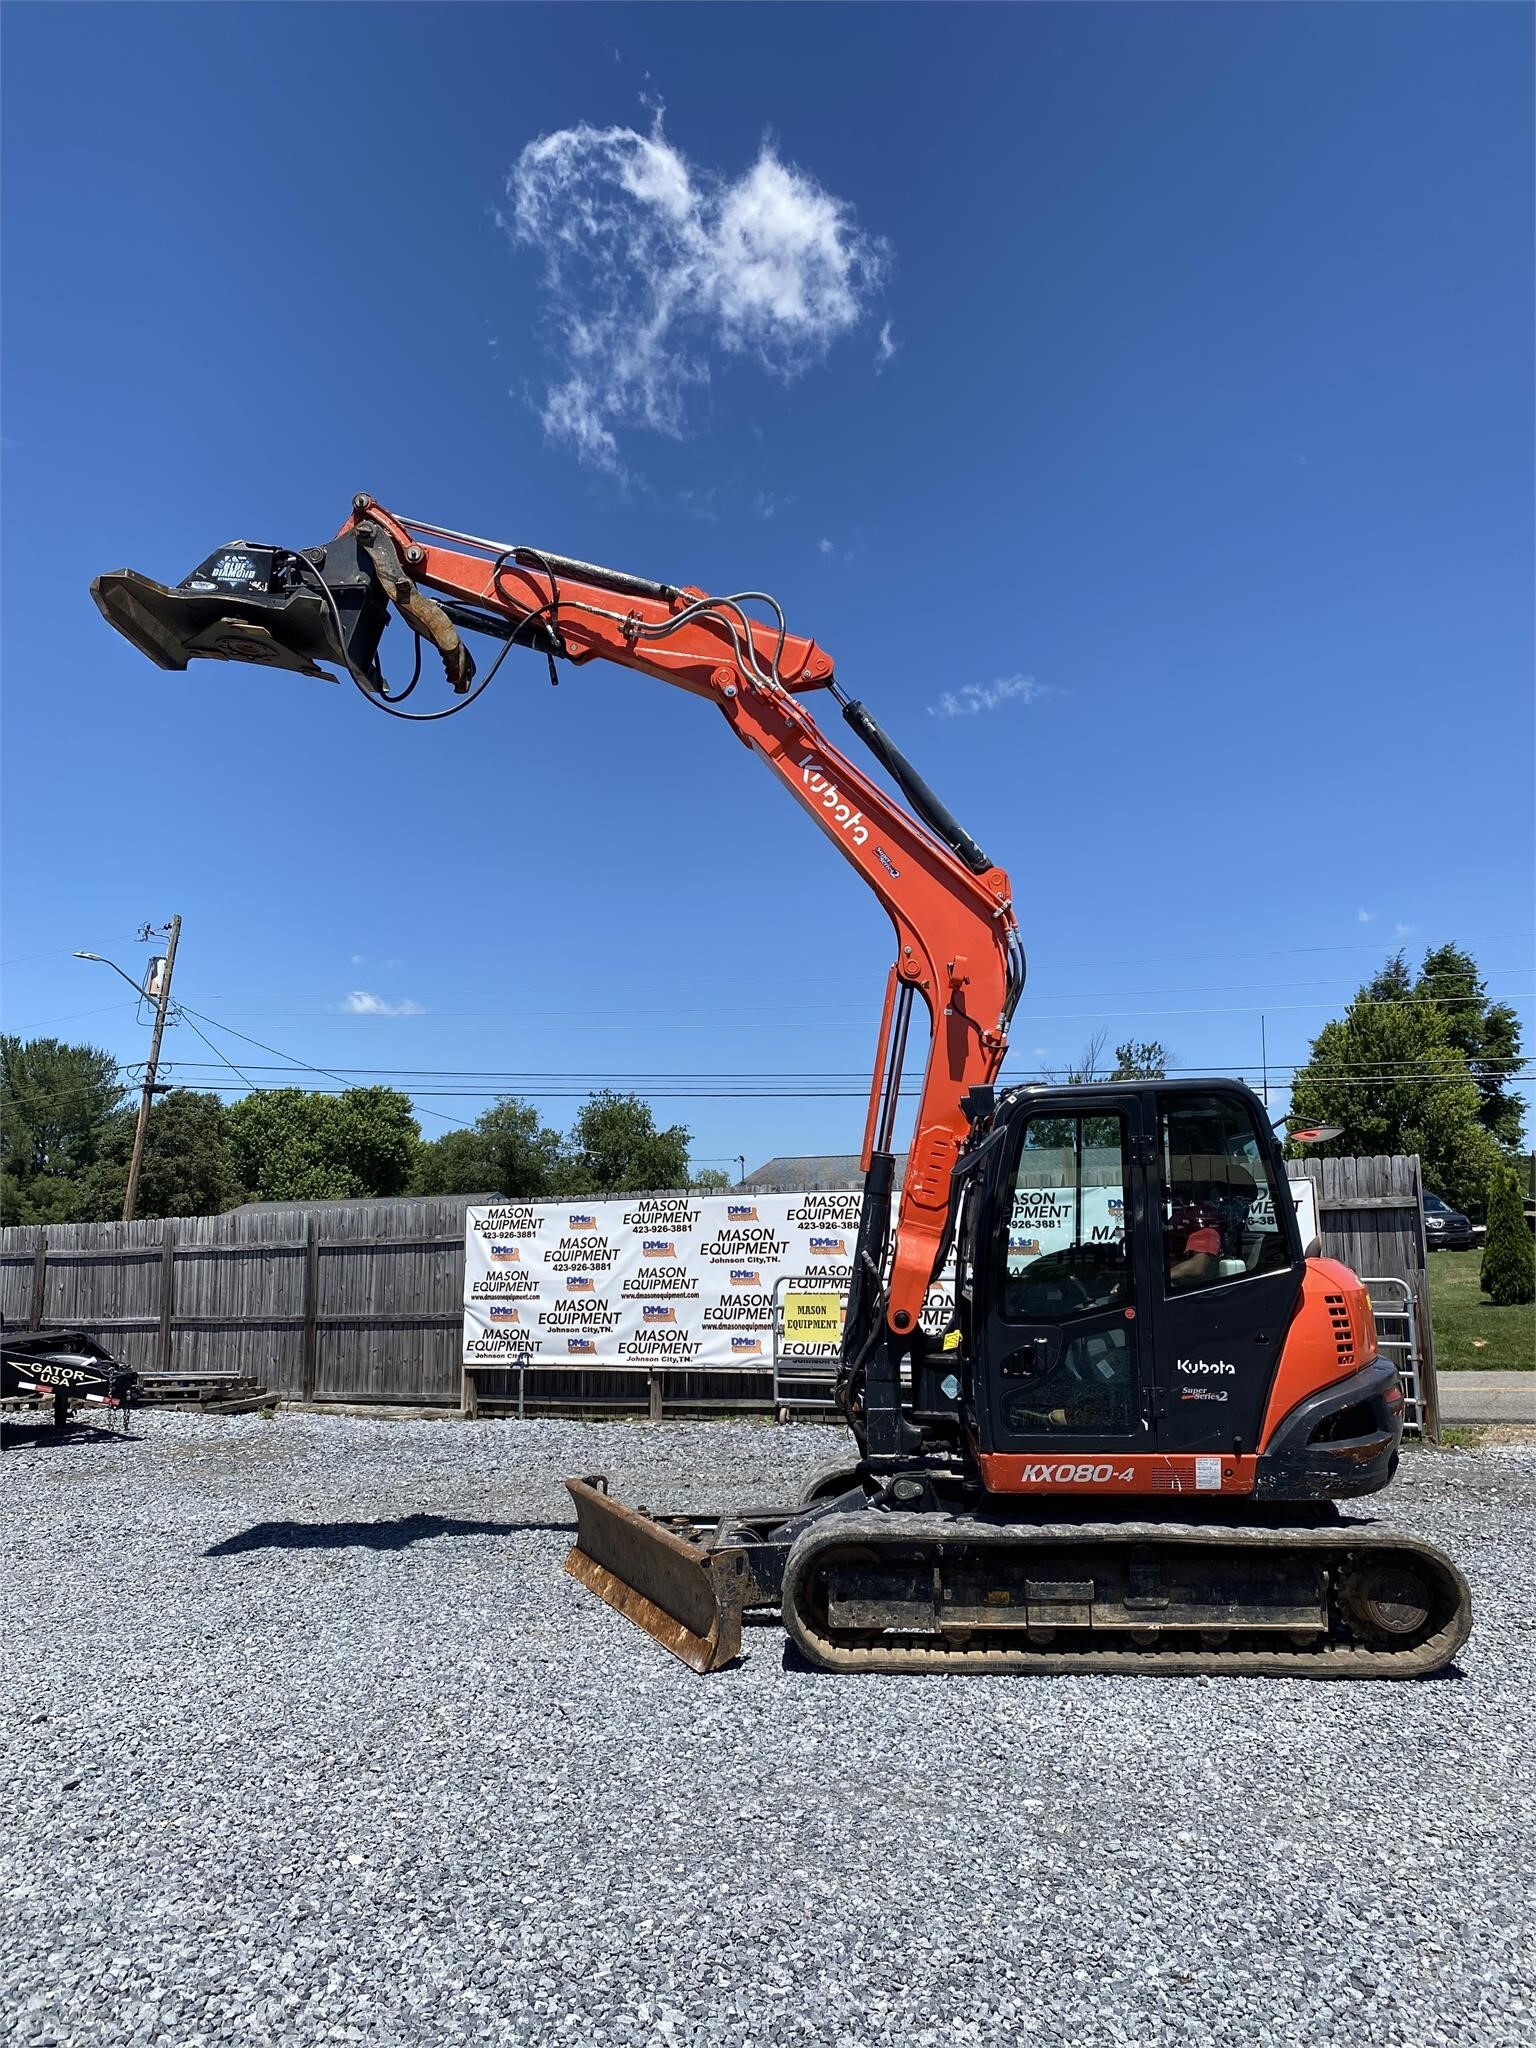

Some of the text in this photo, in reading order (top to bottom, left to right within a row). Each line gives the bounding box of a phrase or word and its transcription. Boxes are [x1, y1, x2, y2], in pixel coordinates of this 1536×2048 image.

[223, 562, 246, 570] BLUE
[212, 568, 256, 578] DIAMOND
[799, 754, 869, 846] Kubota
[804, 1196, 861, 1208] MASON
[1013, 1192, 1056, 1205] ASON
[638, 1200, 688, 1212] MASON
[488, 1208, 534, 1219] MASON
[623, 1211, 702, 1224] EQUIPMENT
[786, 1208, 862, 1220] EQUIPMEN
[474, 1218, 544, 1230] EQUIPMENT
[632, 1224, 692, 1234] 423-926-3881
[798, 1222, 860, 1230] 423-926-388
[718, 1228, 775, 1242] MASON
[560, 1237, 608, 1249] MASON
[700, 1242, 790, 1256] EQUIPMENT
[544, 1249, 621, 1262] EQUIPMENT
[553, 1263, 611, 1272] 423-926-3881
[638, 1267, 687, 1278] MASON
[486, 1271, 529, 1281] MASON
[473, 1282, 540, 1292] EQUIPMENT
[623, 1279, 698, 1290] EQUIPMENT
[788, 1279, 852, 1289] EQUIPME
[621, 1292, 699, 1300] www.dmasonequipment.com
[554, 1300, 608, 1312] MASON
[797, 1306, 827, 1315] MASON
[538, 1312, 622, 1324] EQUIPMENT
[787, 1320, 837, 1330] EQUIPMENT
[482, 1329, 530, 1340] MASON
[634, 1330, 688, 1341] MASON
[467, 1341, 542, 1351] EQUIPMENT
[618, 1343, 702, 1354] EQUIPMENT
[782, 1343, 841, 1356] EQUIPM
[30, 1362, 85, 1380] GATOR
[1177, 1360, 1235, 1374] Kubota
[40, 1374, 70, 1386] USA
[1182, 1386, 1207, 1395] Super
[1021, 1464, 1135, 1482] KX080-4
